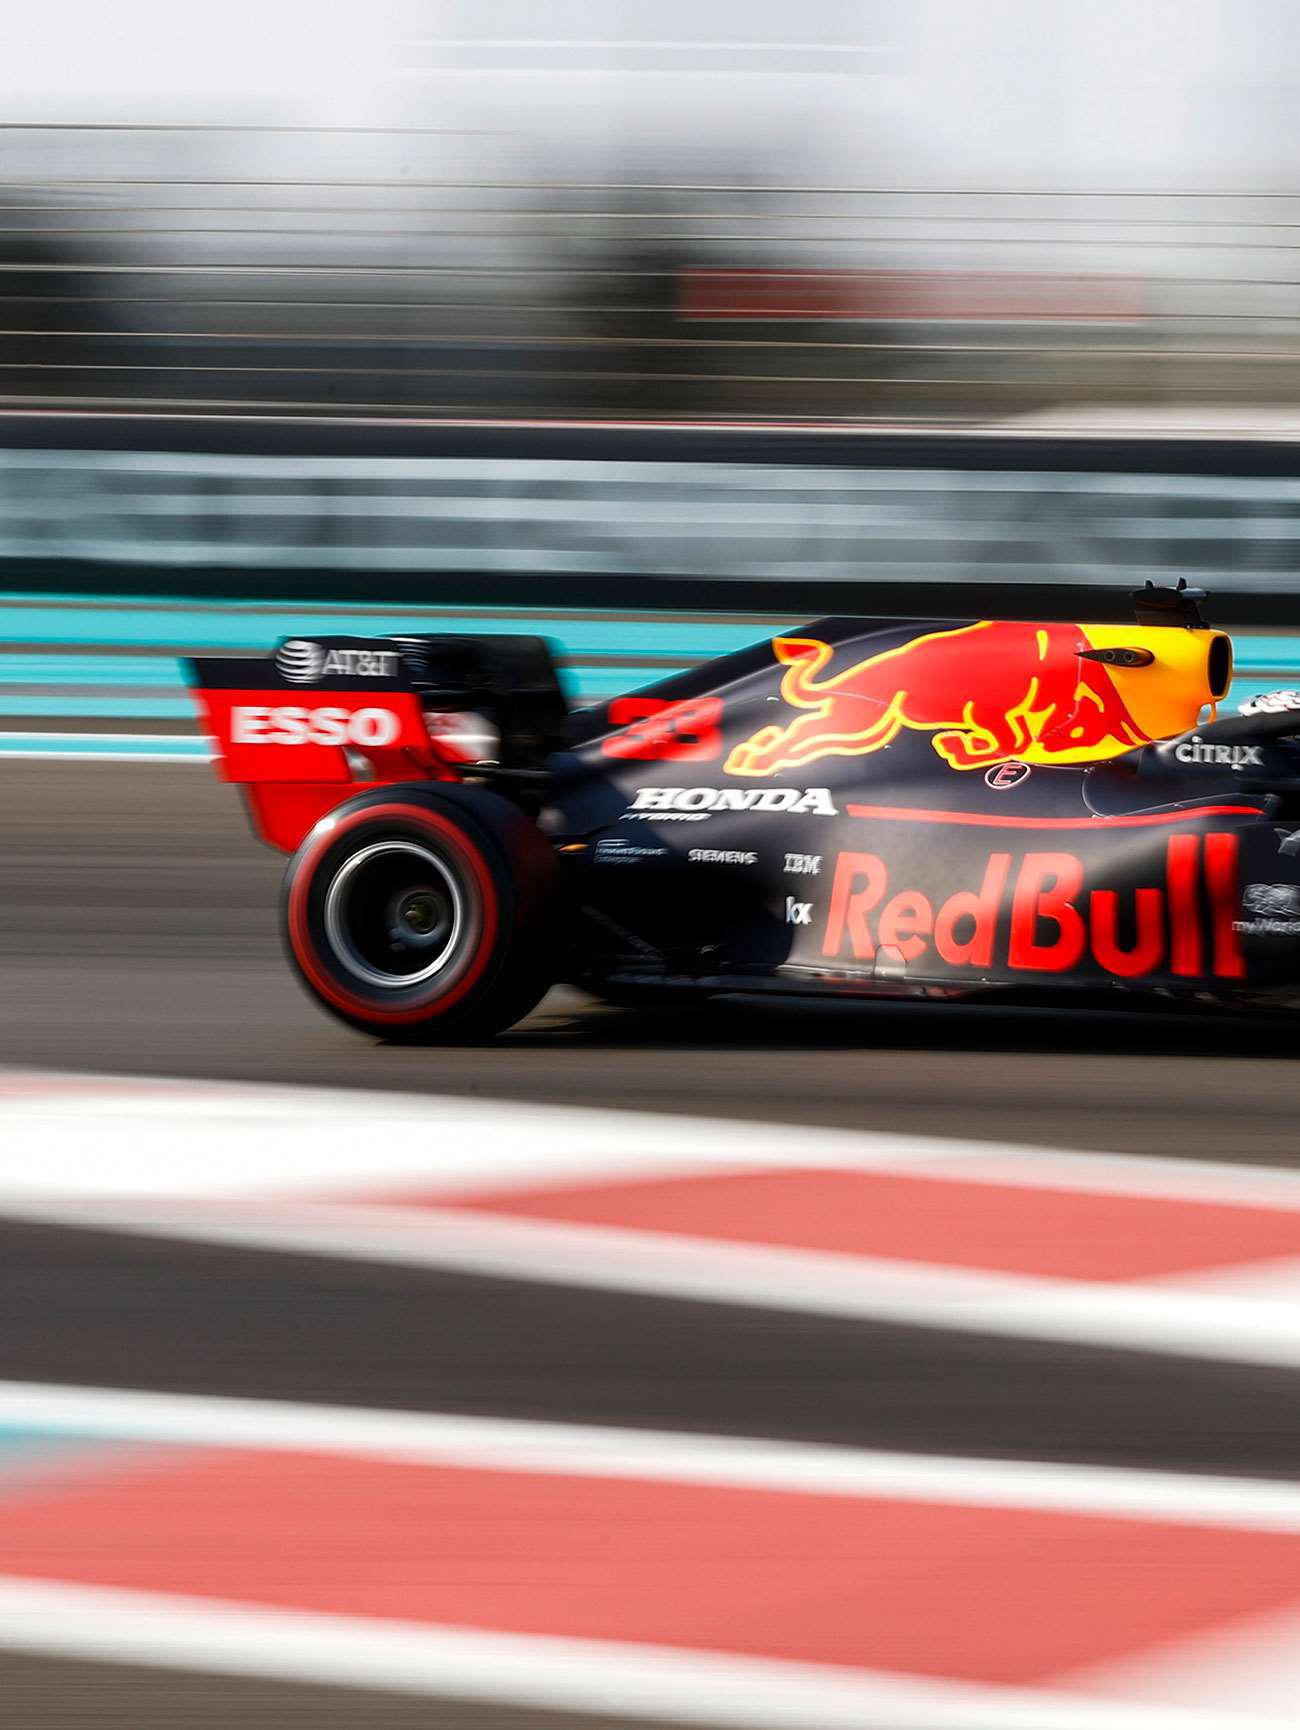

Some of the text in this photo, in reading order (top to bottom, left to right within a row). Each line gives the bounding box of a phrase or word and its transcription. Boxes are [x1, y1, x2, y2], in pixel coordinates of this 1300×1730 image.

[320, 649, 400, 677] AT&T
[230, 705, 400, 746] ESSO
[627, 788, 838, 816] HONDA
[687, 848, 759, 865] SIEMENS
[784, 853, 824, 874] IBM
